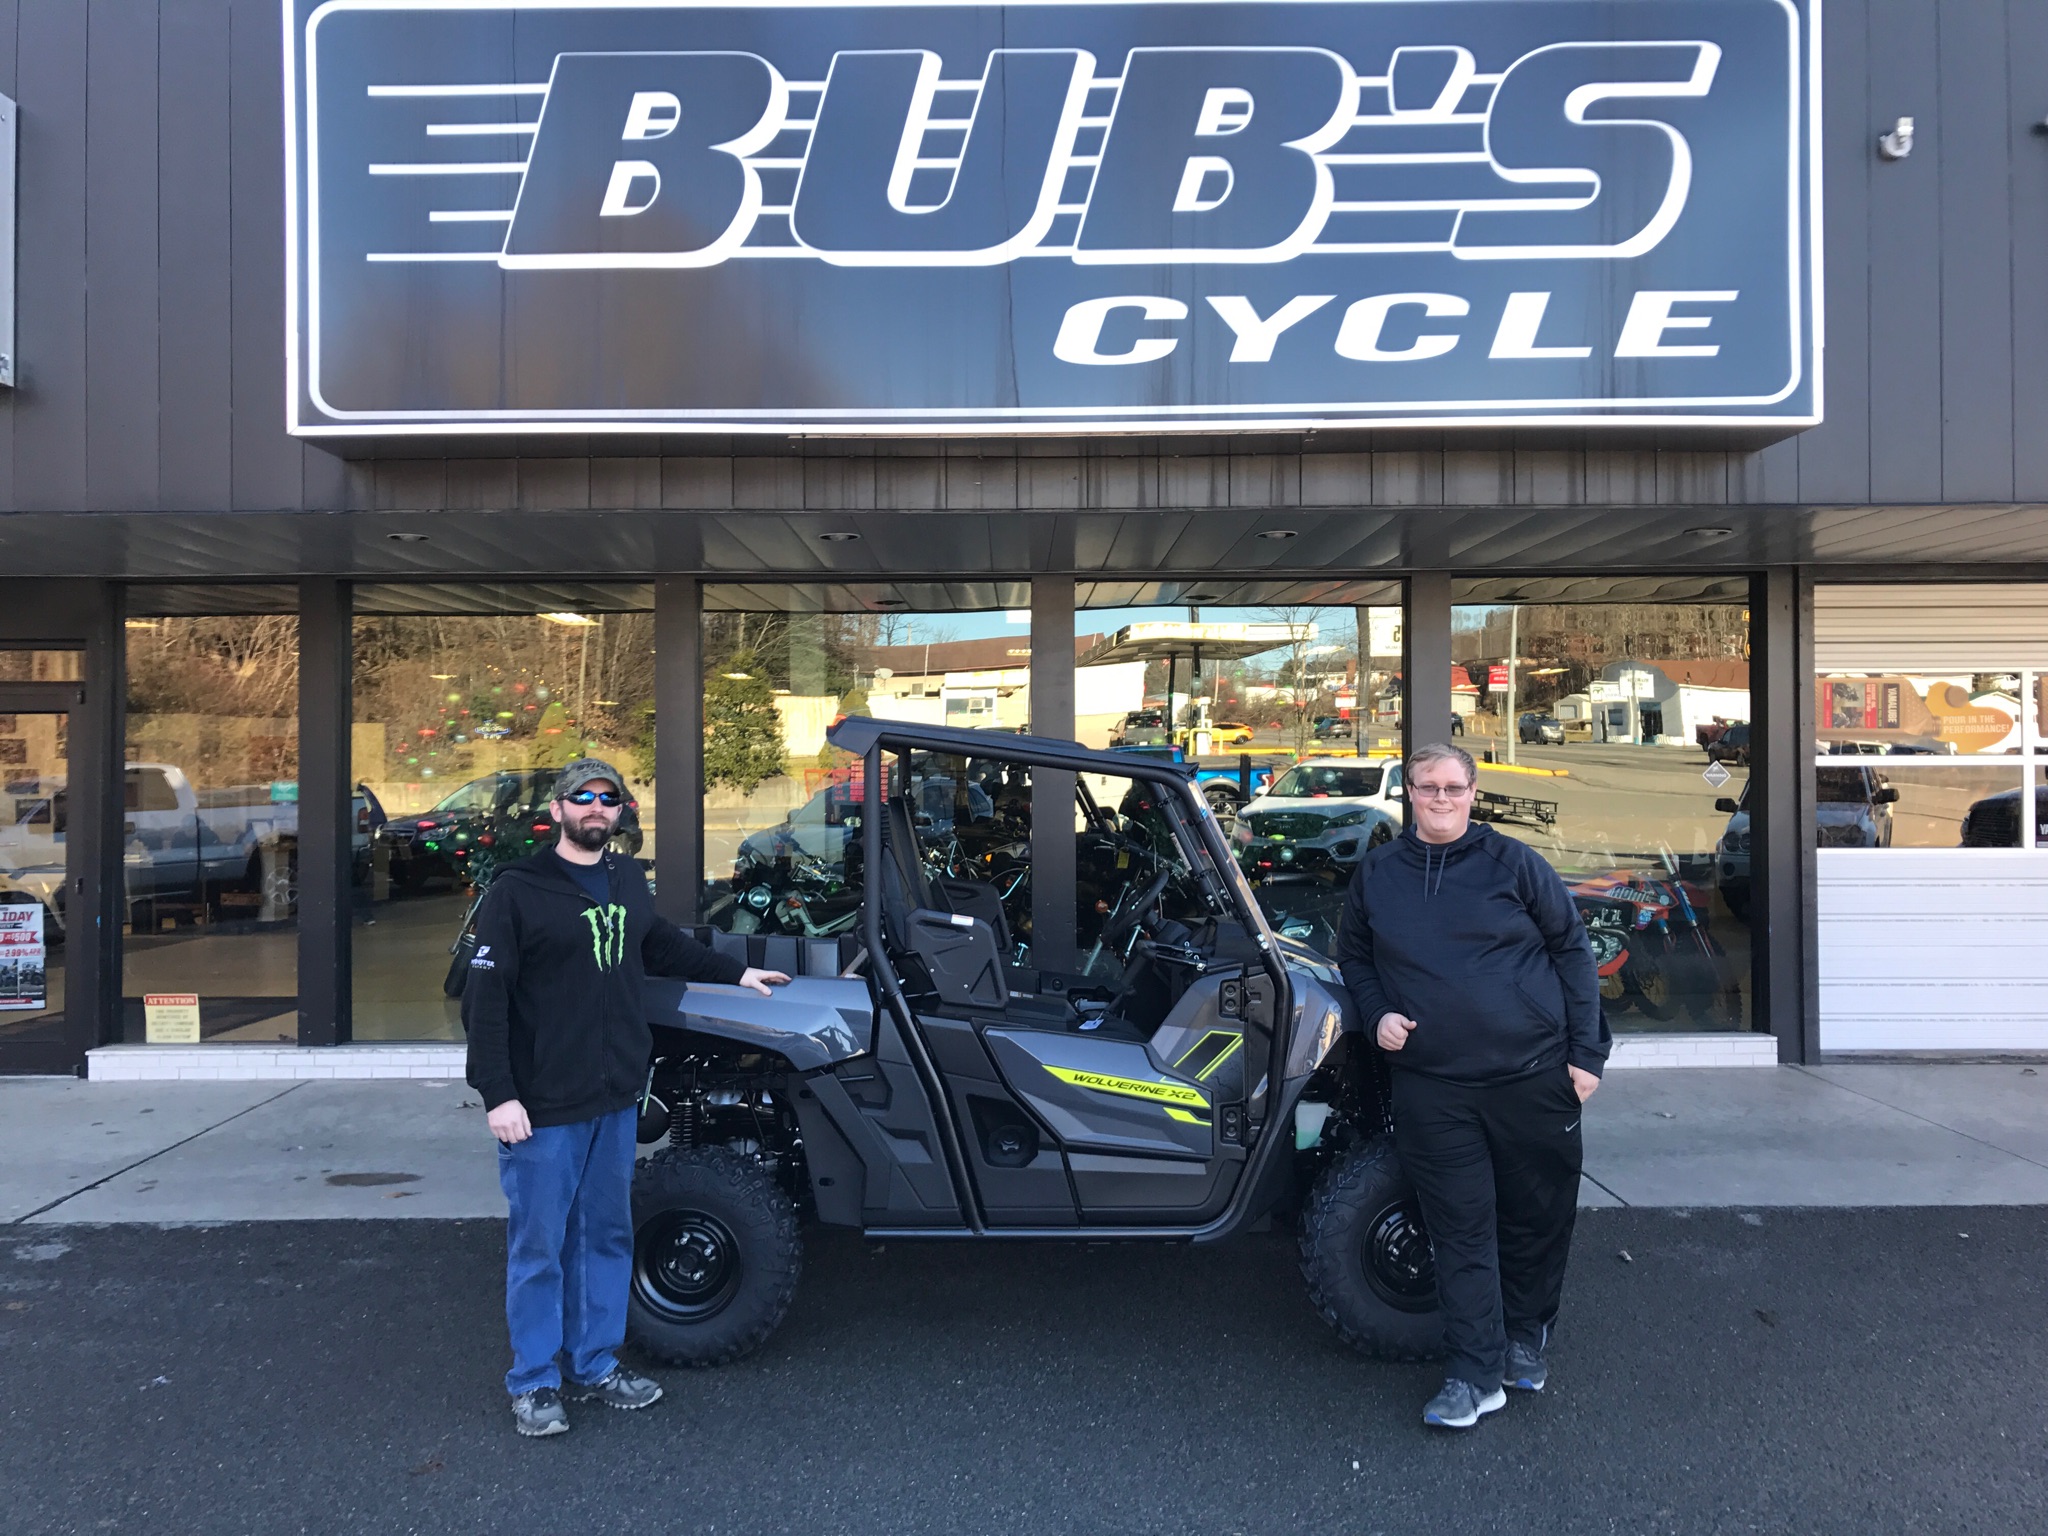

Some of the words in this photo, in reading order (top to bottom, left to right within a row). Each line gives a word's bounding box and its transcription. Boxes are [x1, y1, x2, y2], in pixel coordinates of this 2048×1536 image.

[497, 40, 1722, 270] BUB'S
[1053, 289, 1740, 366] CYCLE
[1887, 687, 1898, 724] YAMALUBE
[1943, 715, 1966, 725] POUR
[1968, 715, 1977, 724] IN
[1980, 714, 1996, 724] THE
[1943, 724, 2010, 734] PERFORMANCE!
[0, 911, 34, 921] IDAY
[147, 997, 195, 1005] ATTENTION
[1073, 1073, 1167, 1096] WOLVERINE
